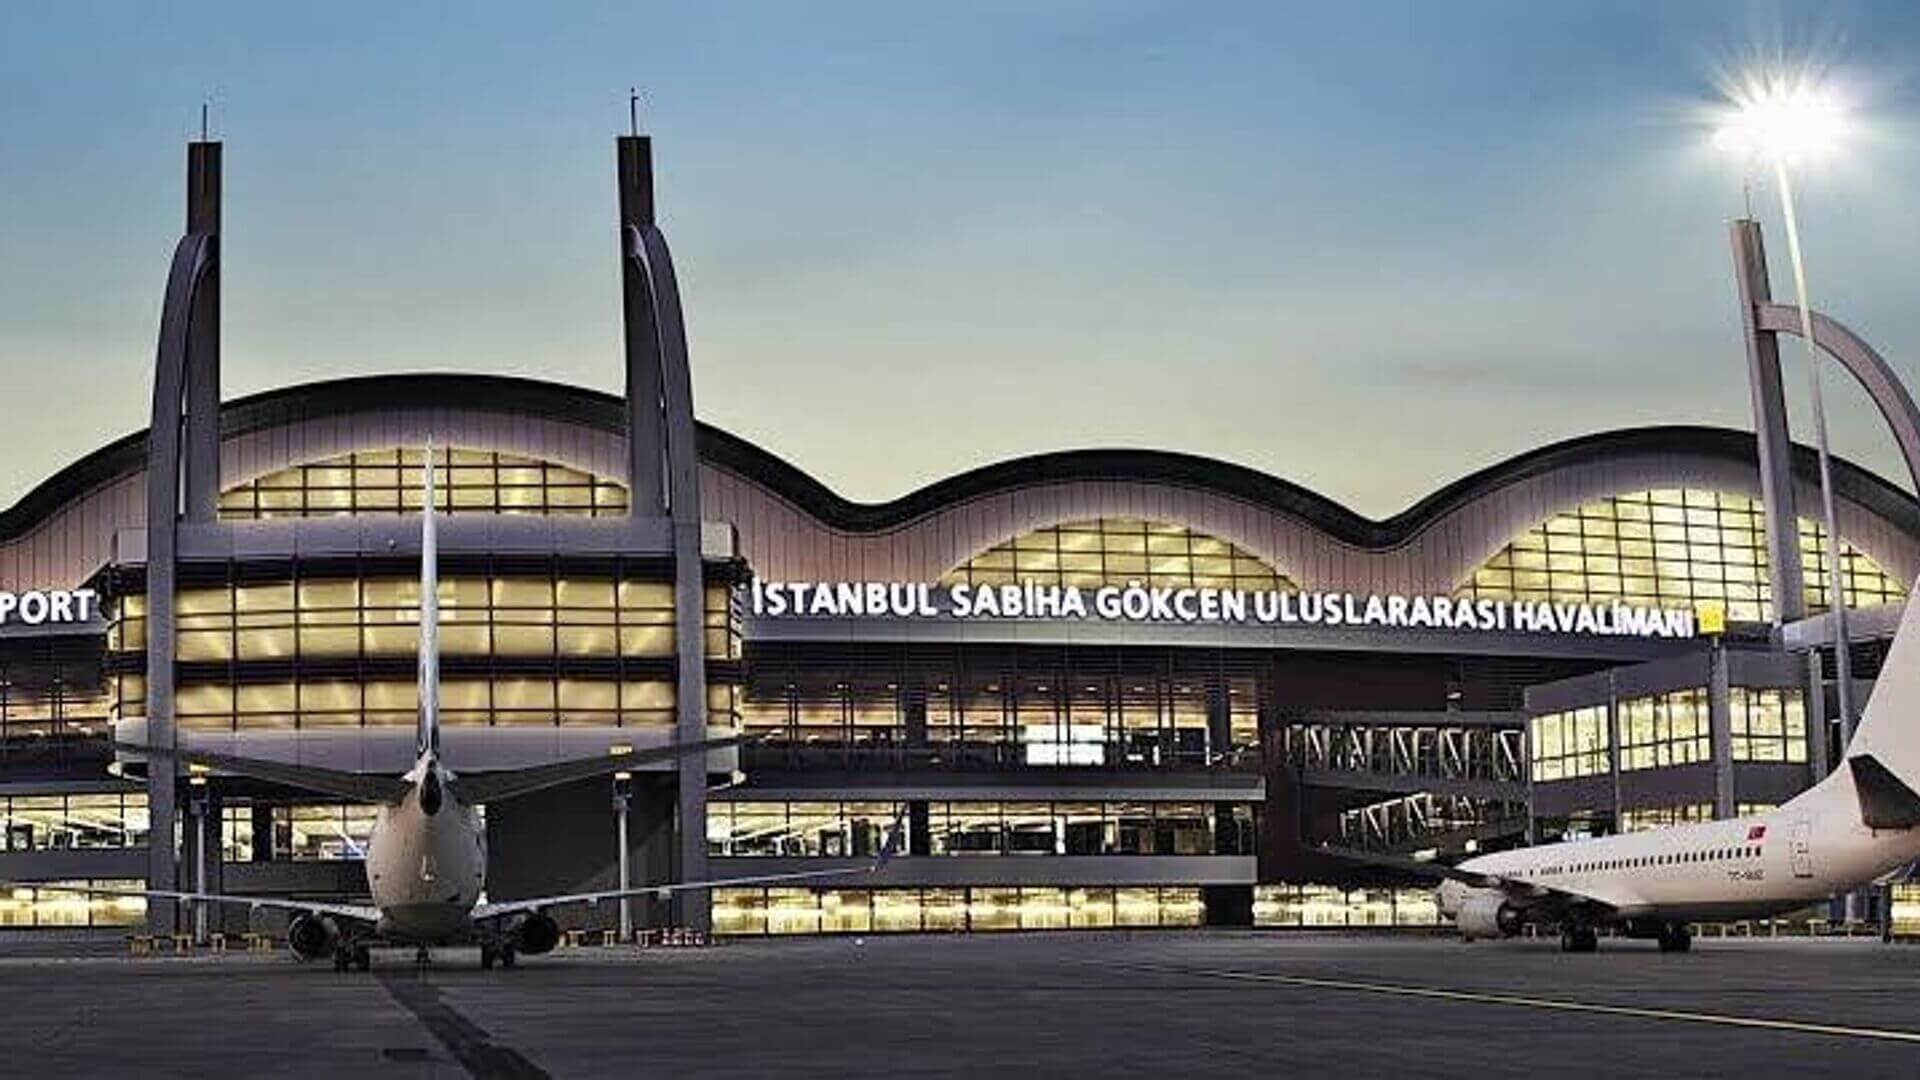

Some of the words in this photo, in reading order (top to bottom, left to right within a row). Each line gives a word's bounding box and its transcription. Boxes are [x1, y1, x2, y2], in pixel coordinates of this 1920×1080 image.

[752, 577, 937, 616] İSTANBUL
[951, 578, 1087, 617] SABİHA
[1096, 581, 1245, 622] GÖKÇEN
[1255, 591, 1506, 630] ULUSLARARASI
[1513, 600, 1693, 637] HAVALİMANI
